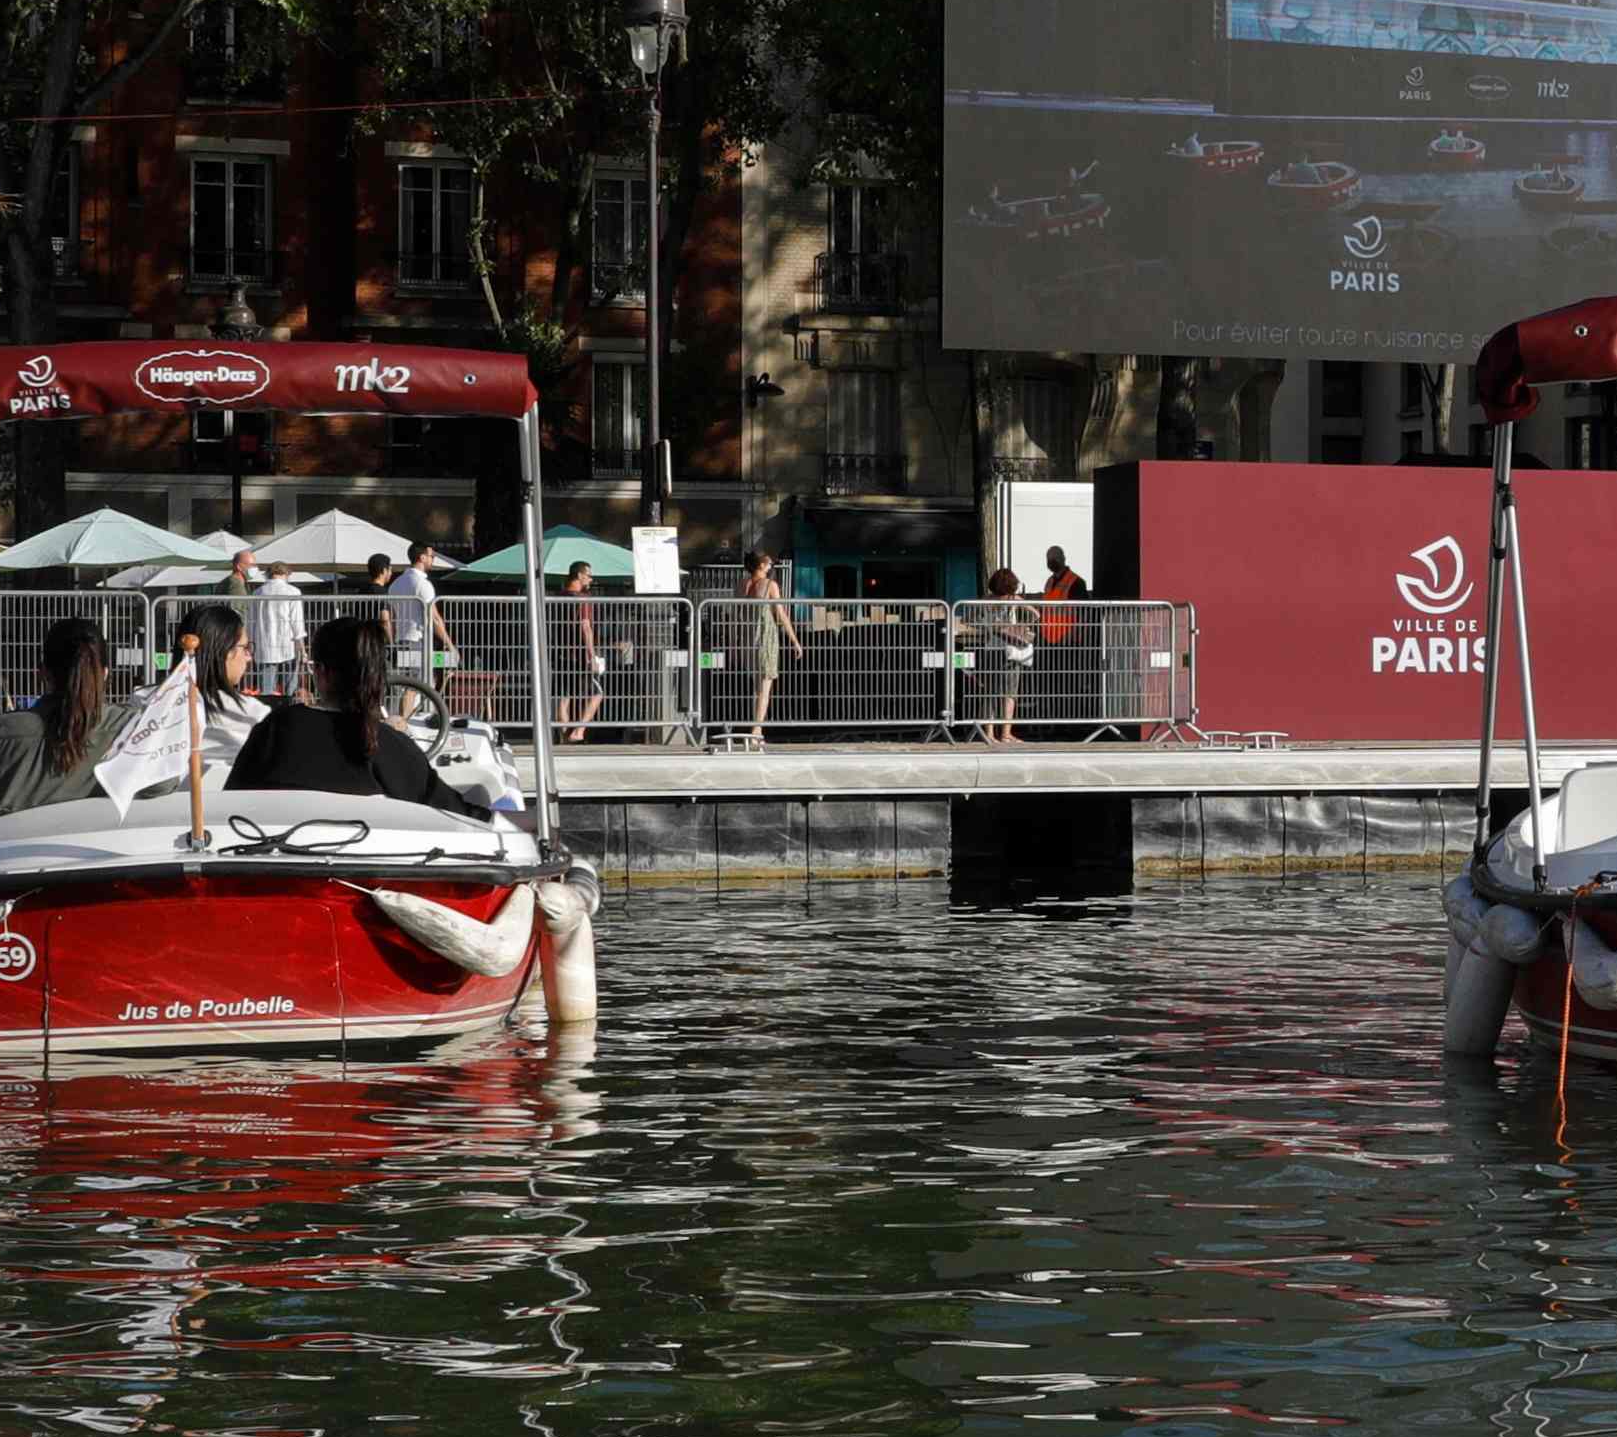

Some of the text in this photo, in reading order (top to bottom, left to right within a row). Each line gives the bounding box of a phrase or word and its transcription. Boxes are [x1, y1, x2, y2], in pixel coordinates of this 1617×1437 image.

[1399, 89, 1432, 101] PARIS
[1330, 270, 1400, 293] PARIS
[1171, 319, 1223, 343] Pour
[1230, 320, 1291, 345] éviter
[1298, 323, 1358, 347] toute
[1363, 325, 1464, 350] nuisance
[149, 366, 257, 386] Häagen-Dazs
[334, 357, 411, 394] mk2
[9, 394, 72, 414] PARIS
[1392, 619, 1478, 632] VILLE DE
[117, 996, 294, 1022] Jus de Poubelle
